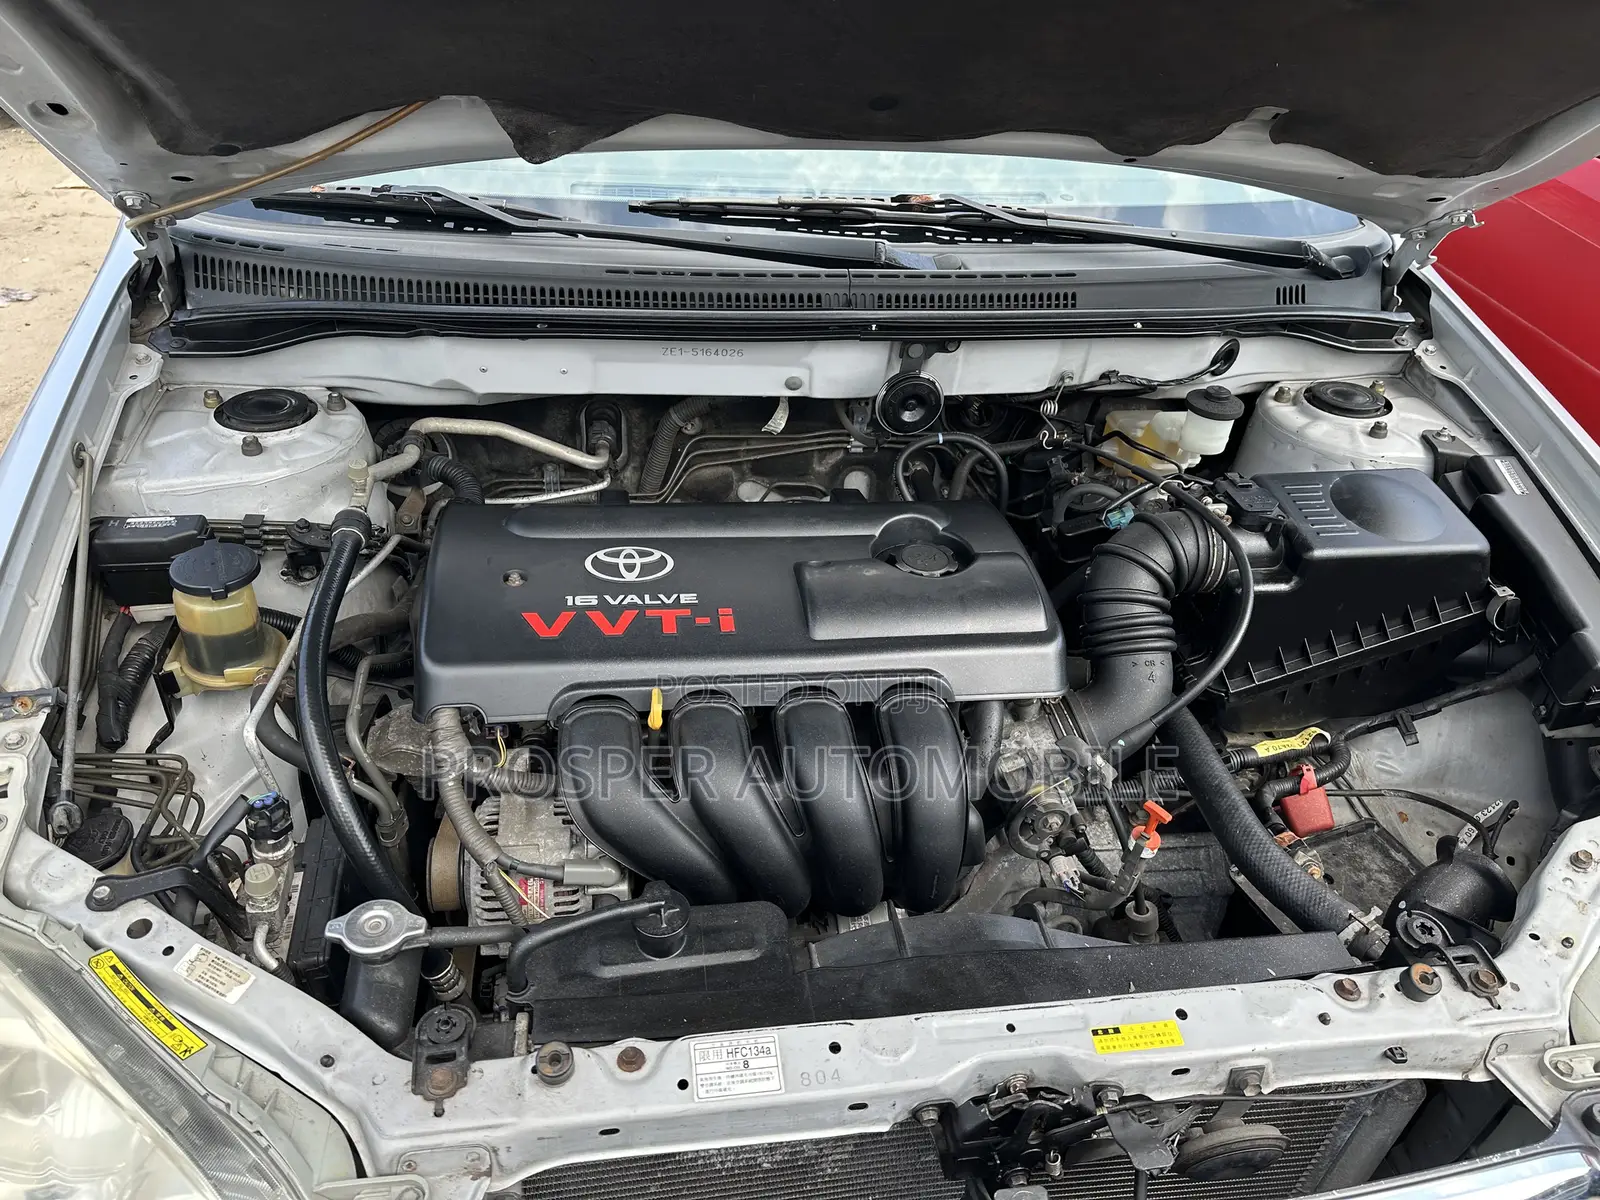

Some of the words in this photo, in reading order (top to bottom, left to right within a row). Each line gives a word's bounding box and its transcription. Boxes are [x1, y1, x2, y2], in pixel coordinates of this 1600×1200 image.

[661, 346, 744, 358] ZE1-5164026
[564, 595, 598, 606] 16
[603, 593, 699, 606] VALVE
[521, 607, 736, 639] VVT-i
[726, 1045, 772, 1060] HFC134a
[742, 1060, 750, 1069] 8
[800, 1068, 842, 1087] 804
